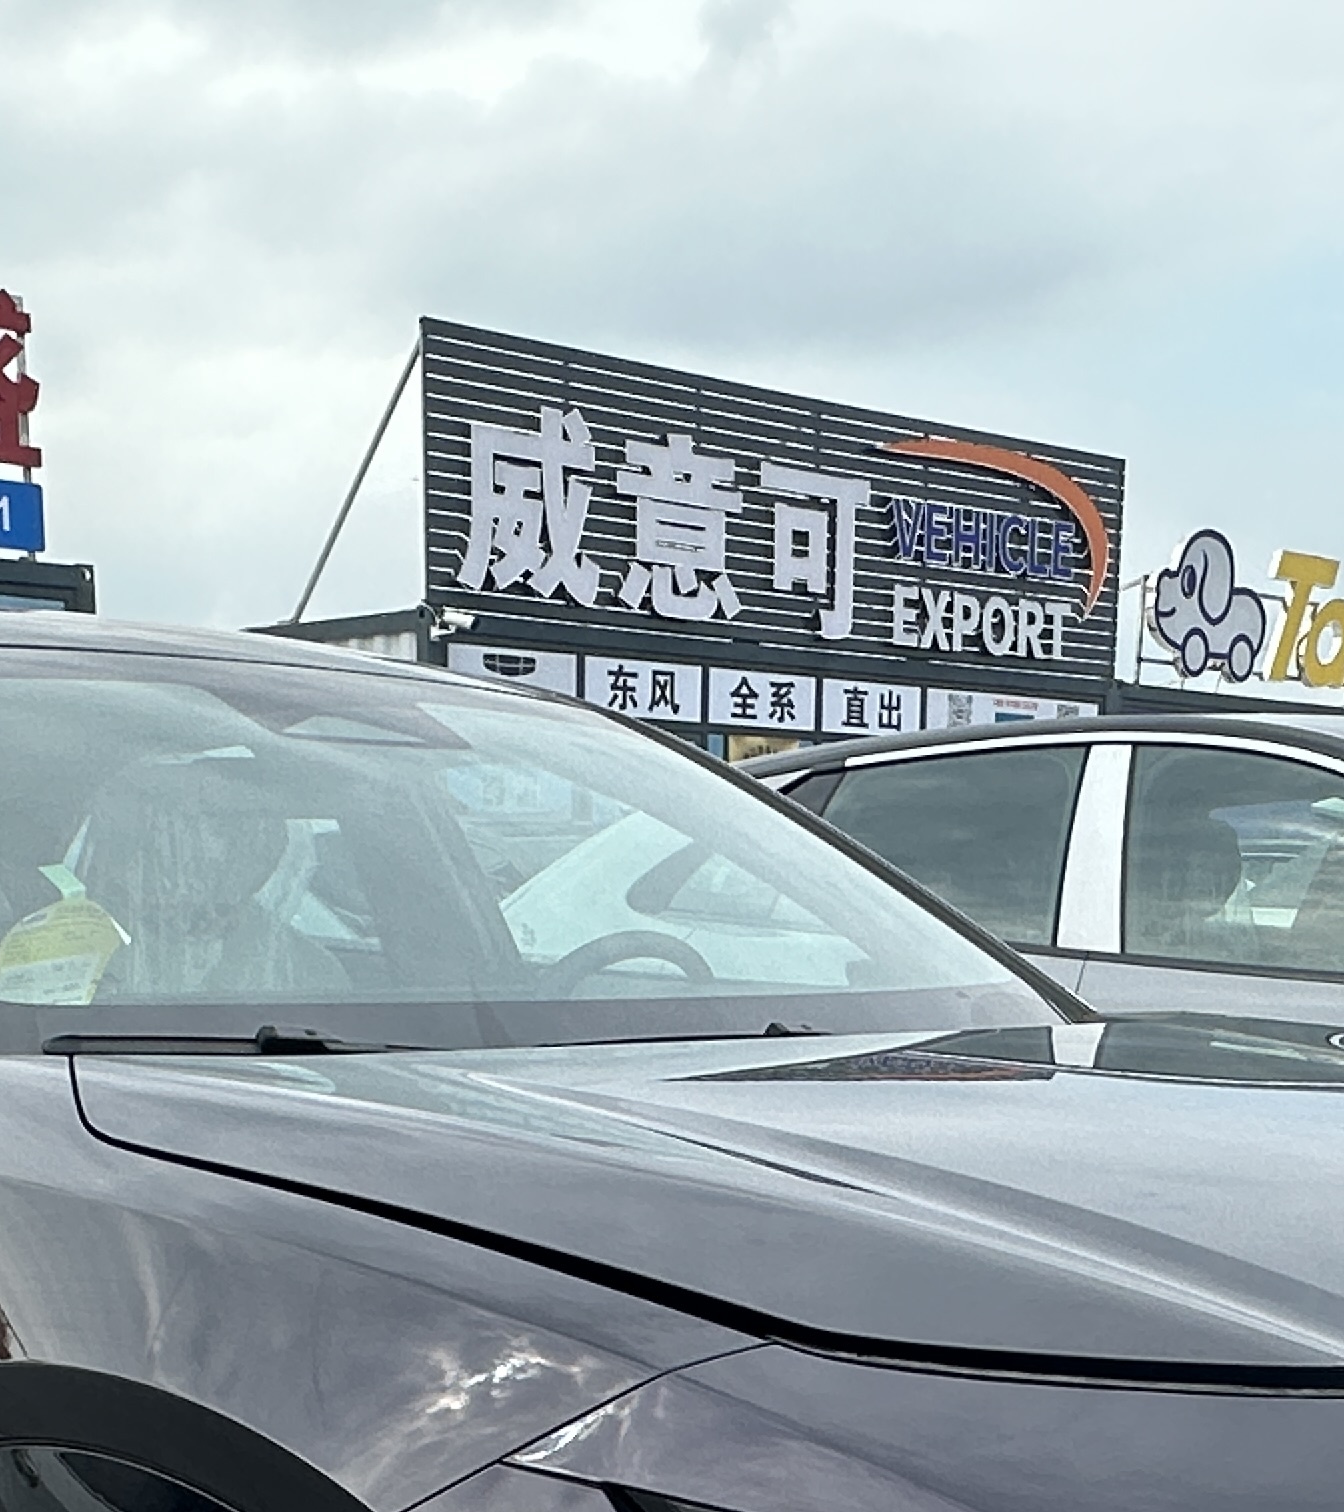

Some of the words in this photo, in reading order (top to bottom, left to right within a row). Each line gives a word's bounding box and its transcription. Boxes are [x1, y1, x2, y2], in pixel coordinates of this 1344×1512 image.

[457, 405, 873, 640] 威意可
[893, 498, 1075, 578] VEHICLE
[892, 584, 1074, 660] EXPORT
[606, 664, 681, 716] 东风
[729, 676, 797, 724] 全系
[841, 687, 904, 732] 直出
